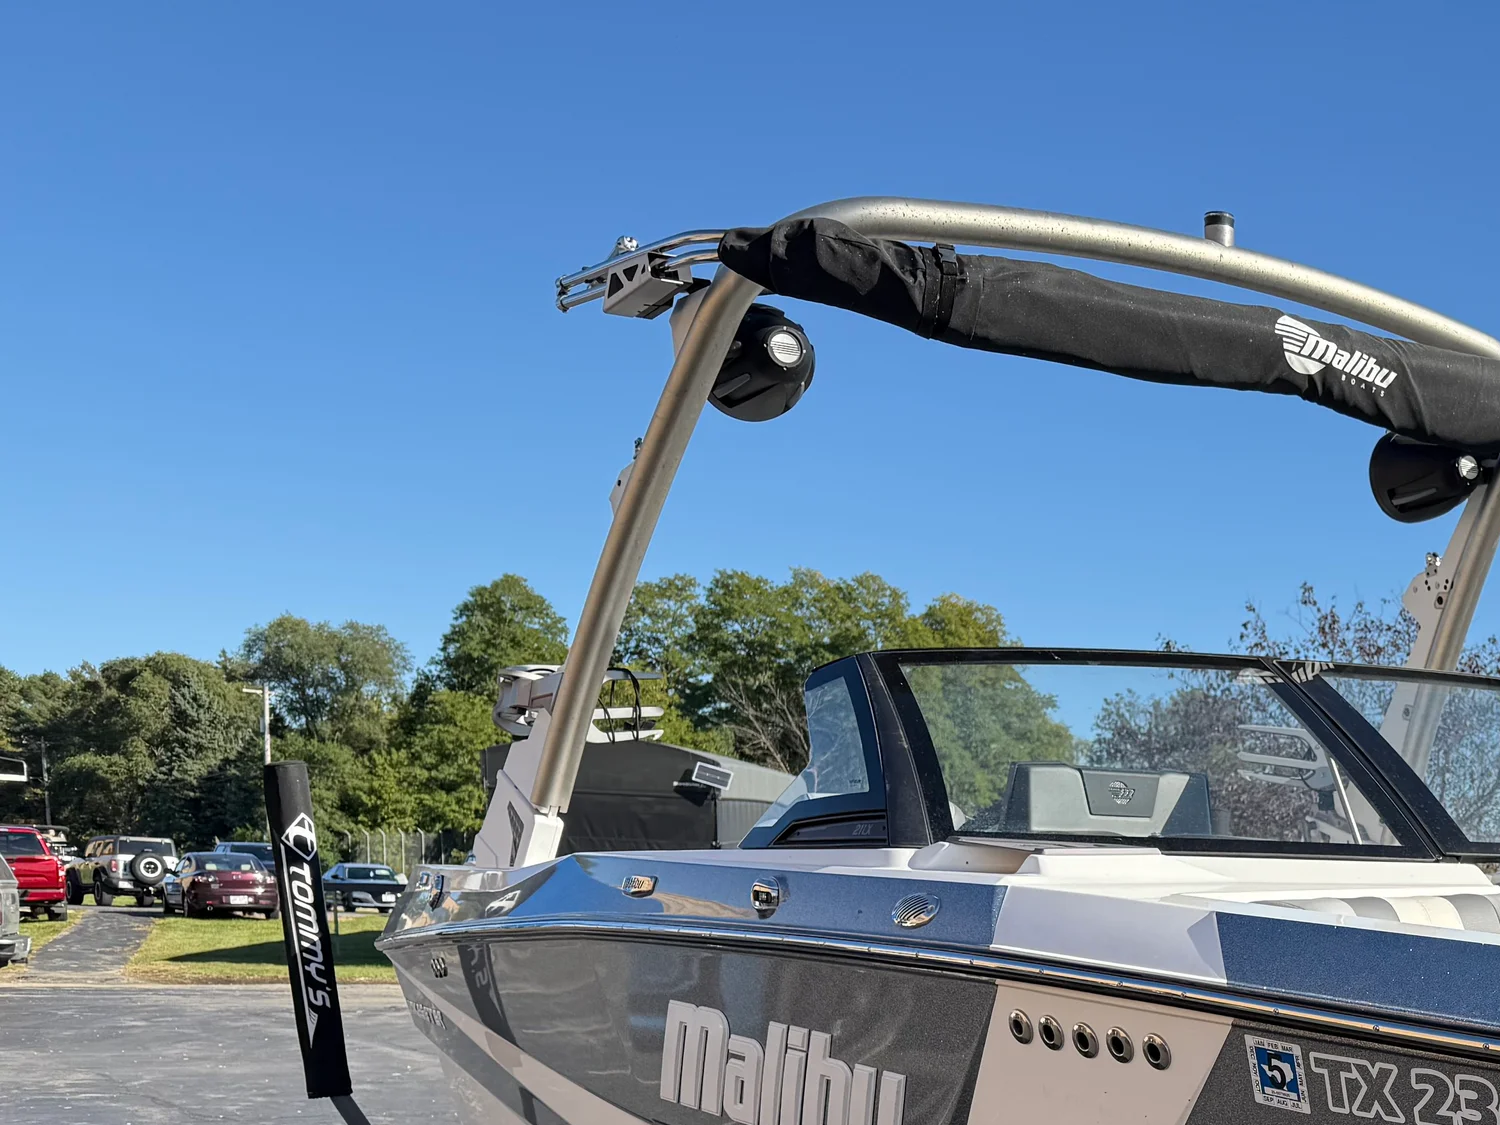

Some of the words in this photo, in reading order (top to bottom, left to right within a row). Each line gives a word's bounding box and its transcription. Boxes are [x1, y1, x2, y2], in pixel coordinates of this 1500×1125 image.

[1299, 334, 1398, 389] Malibu
[1341, 375, 1385, 397] BOATS
[1267, 1052, 1287, 1090] 5
[1308, 1051, 1406, 1124] TX
